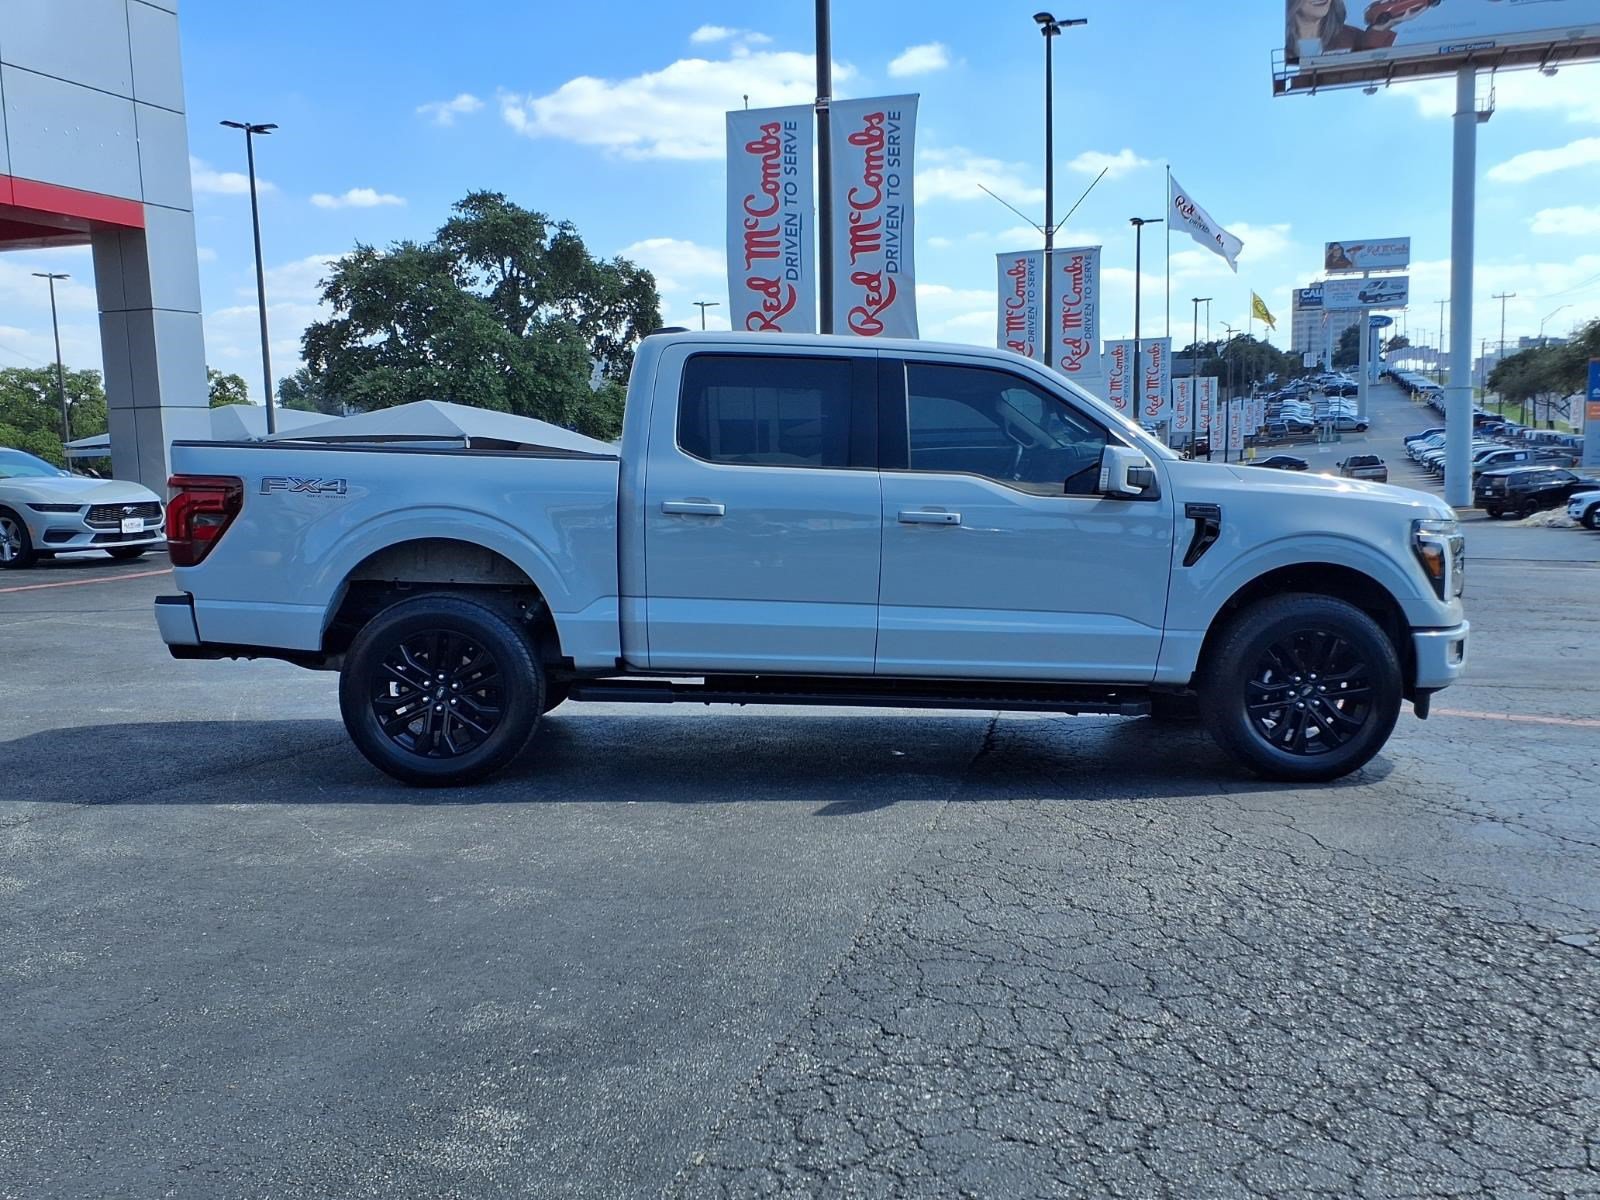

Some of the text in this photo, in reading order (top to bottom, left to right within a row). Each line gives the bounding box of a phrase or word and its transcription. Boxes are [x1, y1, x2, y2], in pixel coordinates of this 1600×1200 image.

[784, 121, 799, 281] DRIVEN TO SERVE
[885, 111, 901, 274] DRIVEN TO SERVE
[743, 121, 797, 332] Red McCombs
[847, 111, 897, 337] Red McCombs
[1027, 290, 1035, 303] TO
[1084, 286, 1092, 300] TO
[1061, 338, 1090, 371] Red
[1145, 394, 1164, 416] Red
[259, 476, 347, 495] FX4
